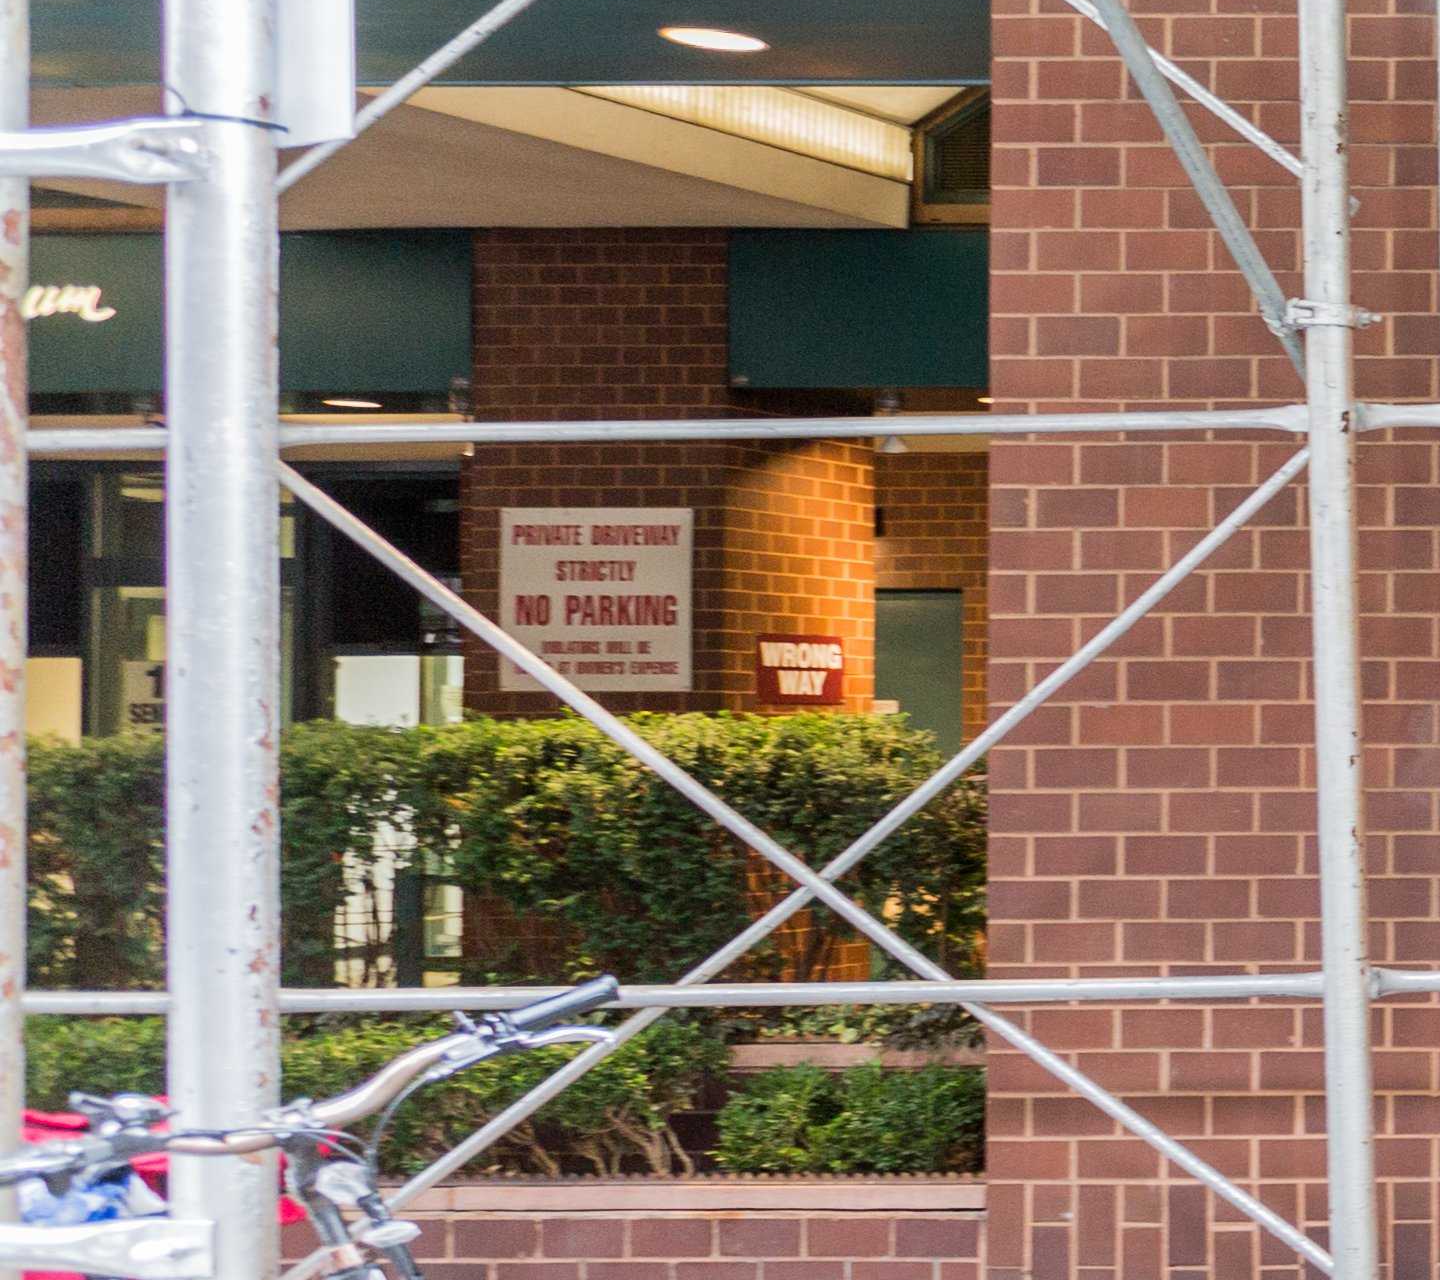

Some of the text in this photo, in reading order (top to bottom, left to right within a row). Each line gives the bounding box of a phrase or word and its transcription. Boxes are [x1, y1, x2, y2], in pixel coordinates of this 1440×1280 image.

[511, 524, 681, 546] PRIVATE DRIVEWAY
[555, 559, 637, 582] STRICTLY
[514, 594, 679, 626] NO PARKING
[759, 642, 843, 670] WRONG
[776, 670, 828, 696] WAY
